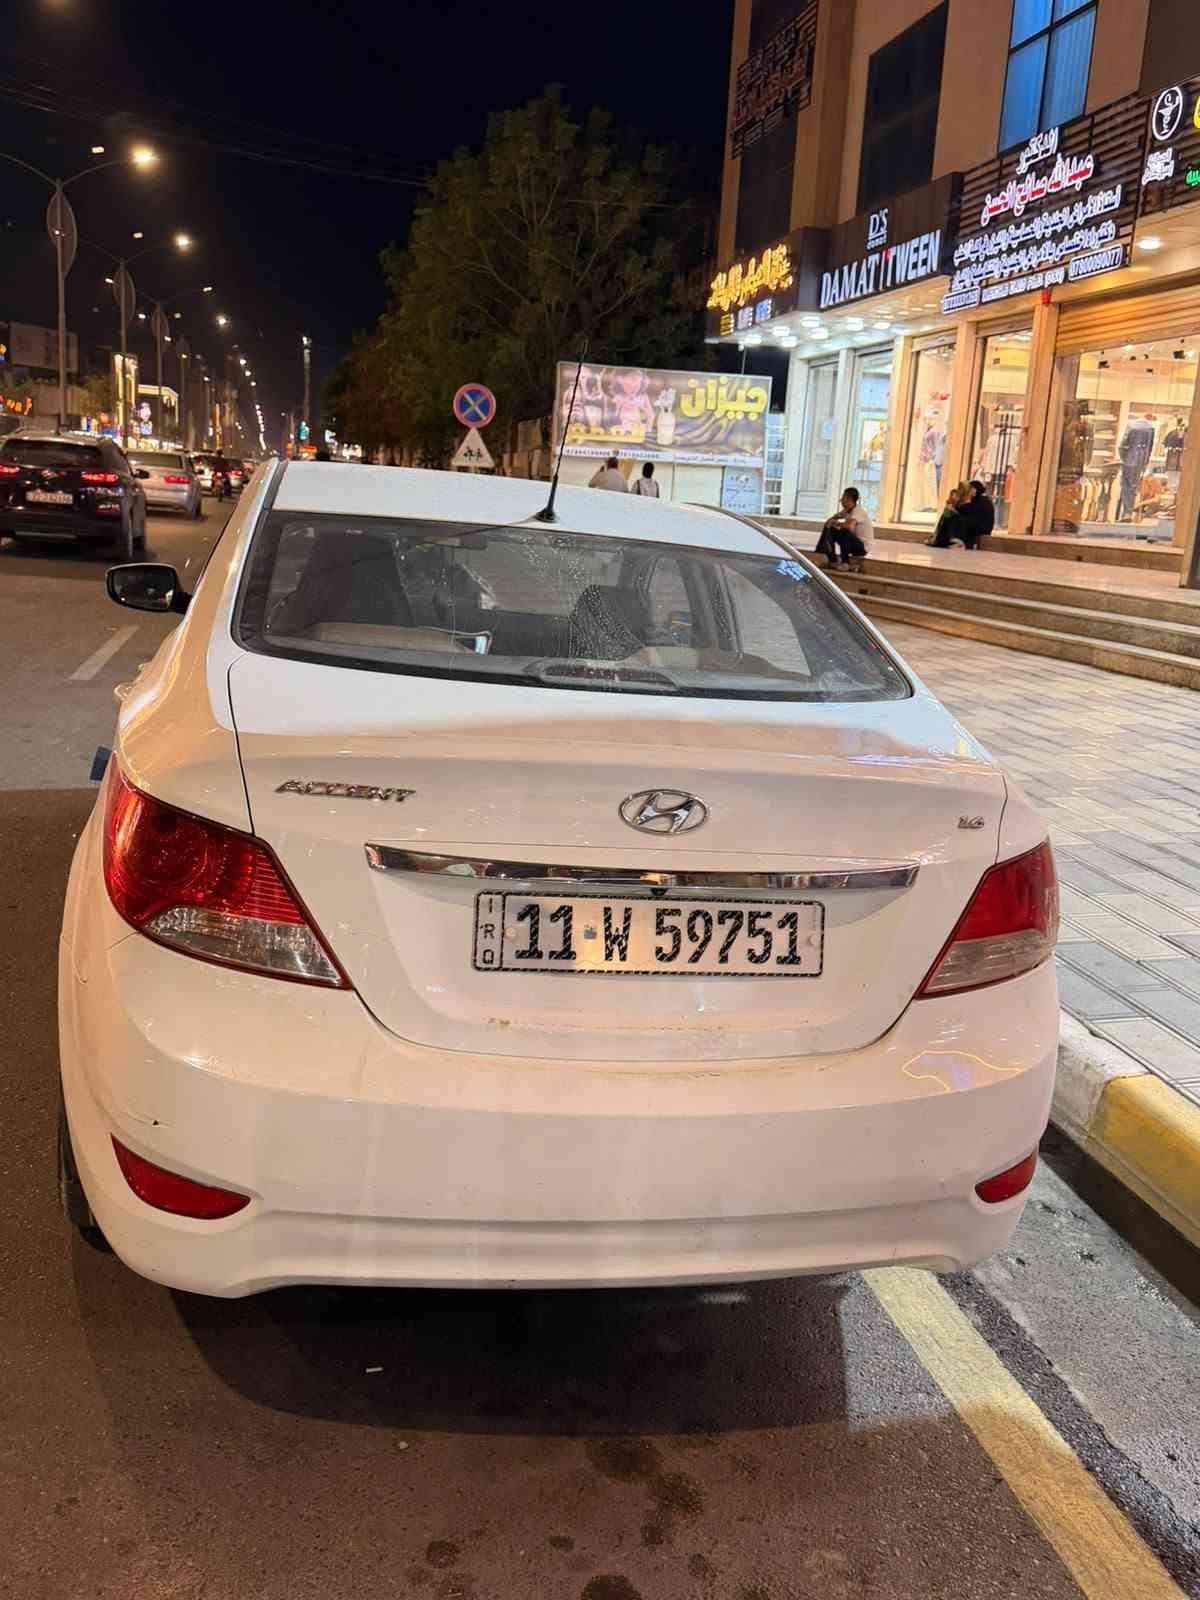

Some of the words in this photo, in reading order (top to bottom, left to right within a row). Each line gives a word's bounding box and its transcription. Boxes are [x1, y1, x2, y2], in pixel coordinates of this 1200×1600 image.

[820, 253, 880, 308] DAMAT
[680, 376, 768, 420] جيزان
[275, 780, 417, 802] ACCENT
[515, 904, 577, 960] 11
[603, 906, 633, 962] W
[655, 908, 801, 965] 59751
